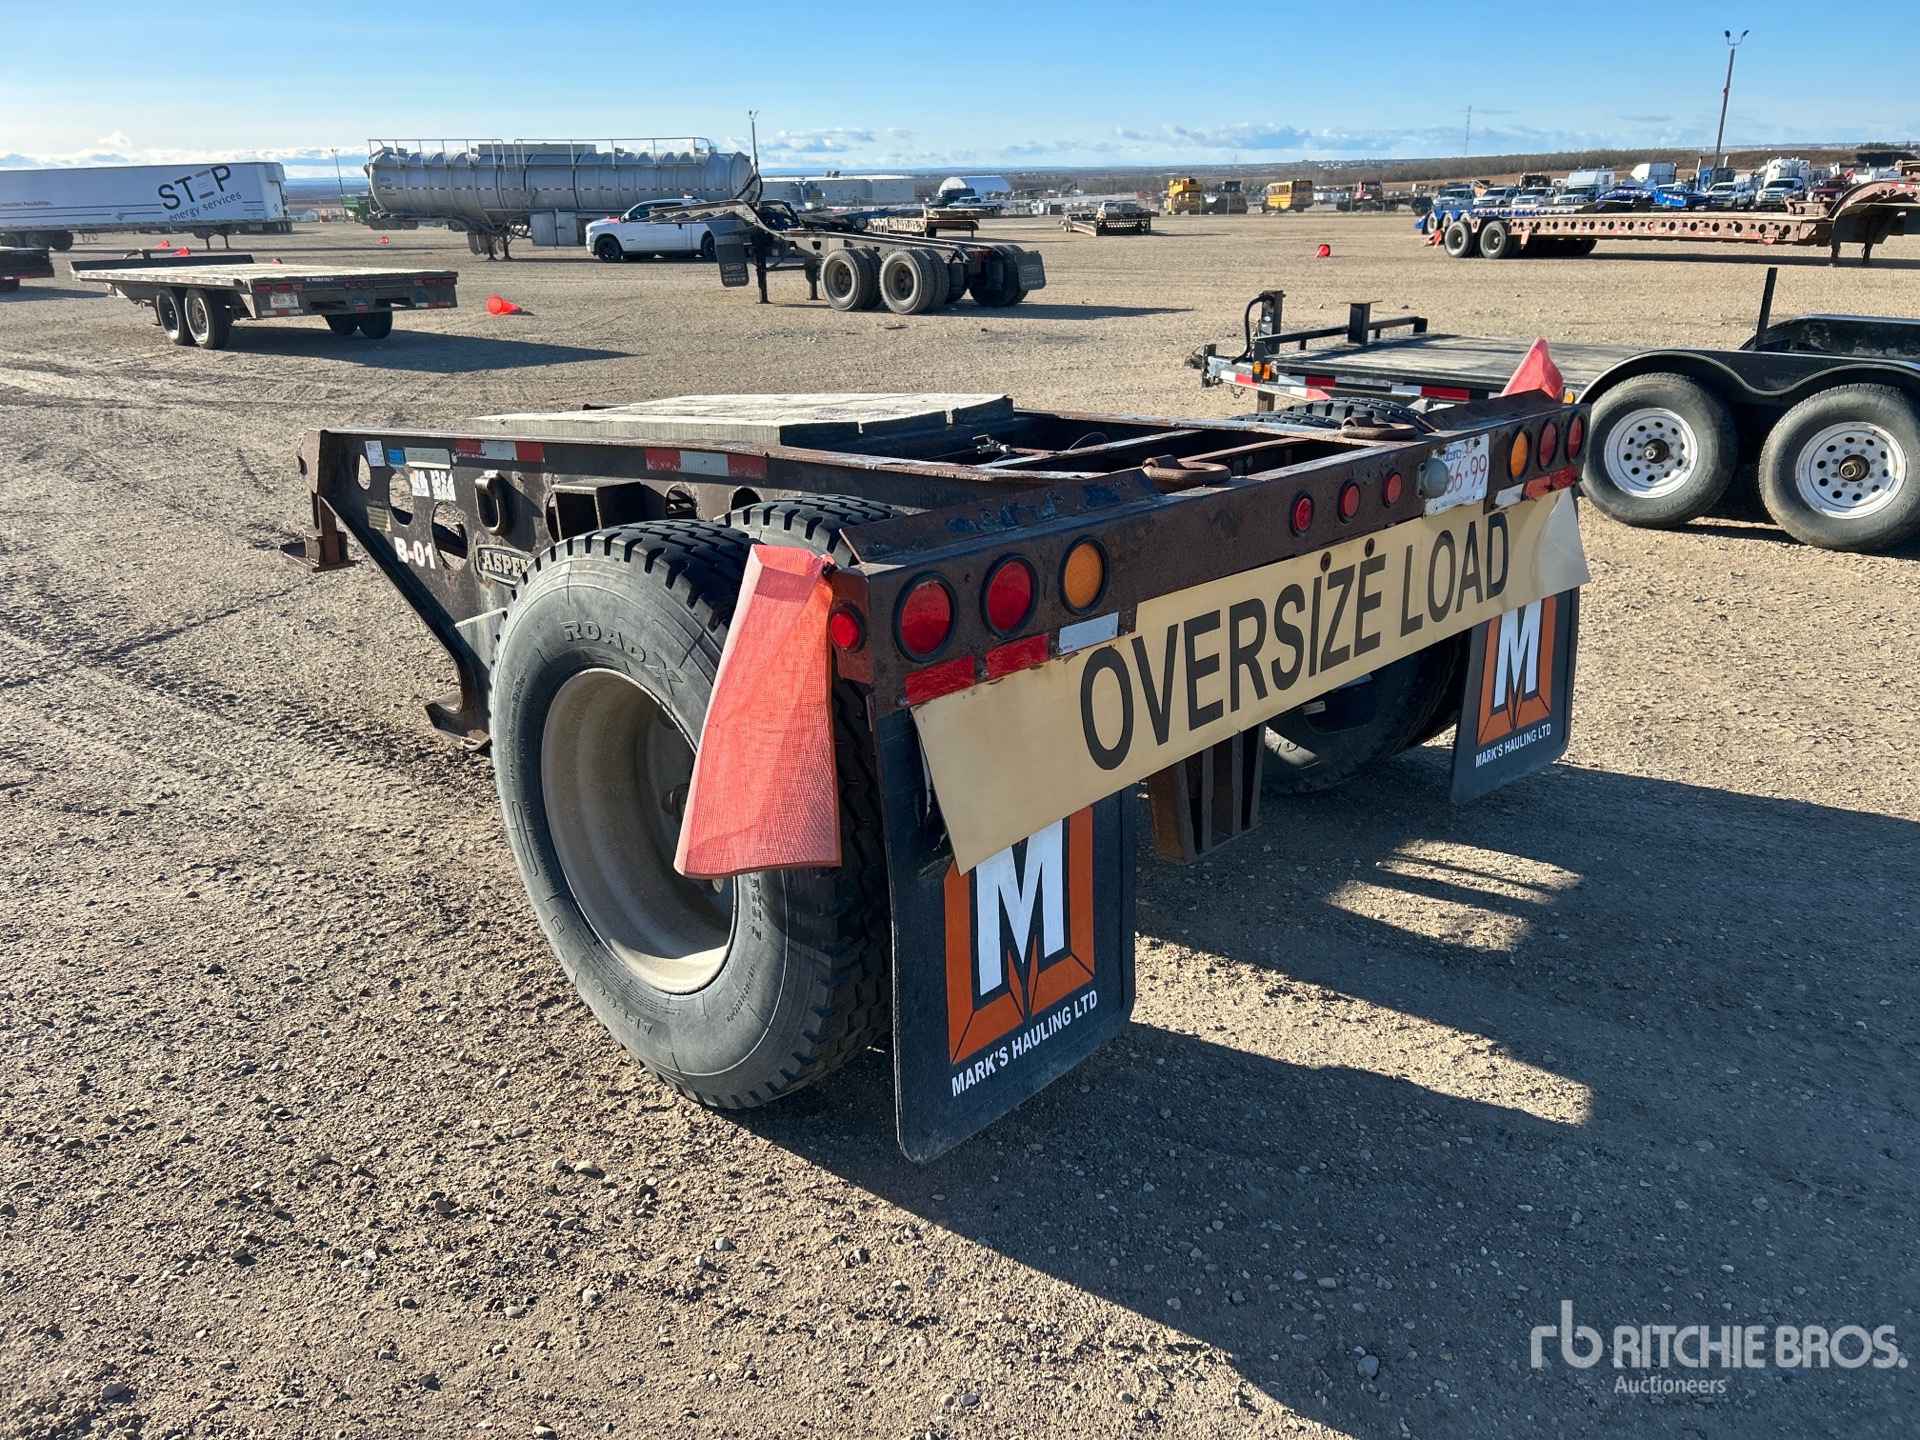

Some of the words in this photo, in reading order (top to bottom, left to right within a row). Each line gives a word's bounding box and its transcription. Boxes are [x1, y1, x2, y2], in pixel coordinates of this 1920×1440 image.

[158, 165, 230, 210] STEP
[168, 206, 200, 223] energy
[202, 192, 242, 211] services
[394, 536, 436, 570] B-01
[483, 550, 531, 577] ASPEN
[1081, 553, 1387, 771] OVERSIZE
[1400, 511, 1509, 637] LOAD
[1493, 600, 1542, 709] M
[1475, 744, 1503, 768] MARK'S
[1505, 729, 1537, 755] HAULING
[1538, 723, 1551, 740] LTD
[976, 818, 1065, 996] M
[952, 1046, 1009, 1097] MARK'S
[1012, 1006, 1071, 1060] HAULING
[1074, 989, 1098, 1019] LTD
